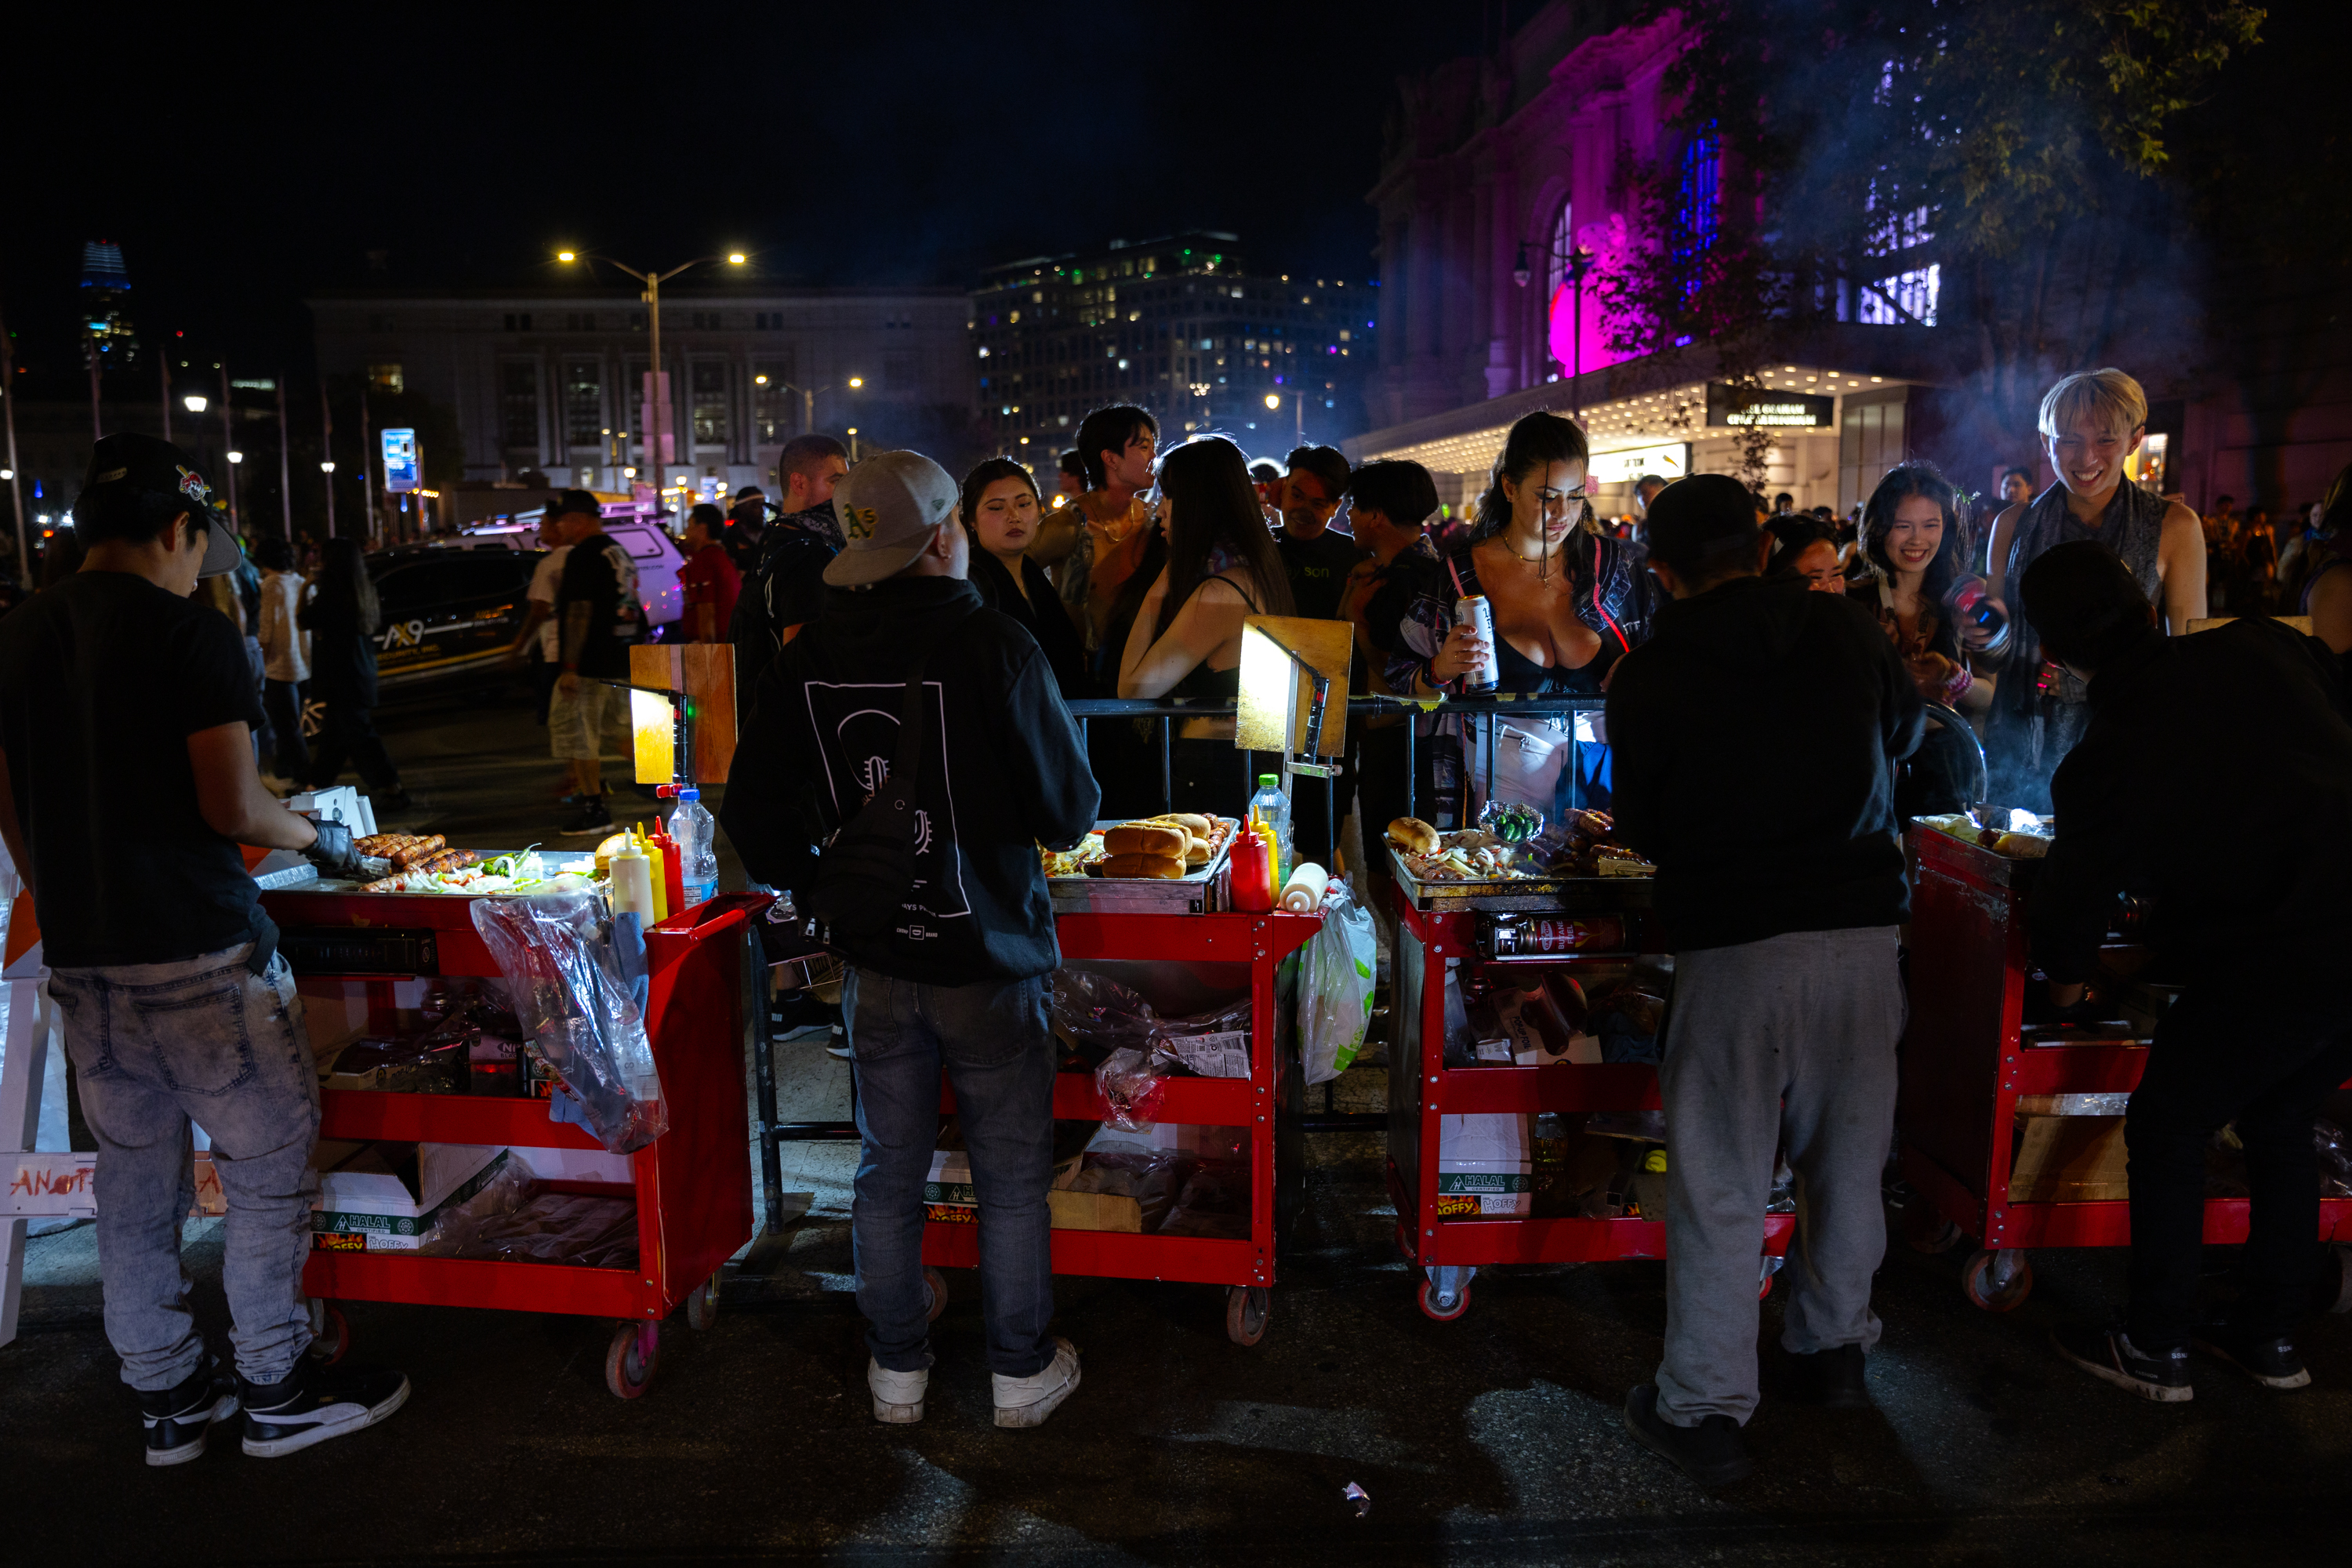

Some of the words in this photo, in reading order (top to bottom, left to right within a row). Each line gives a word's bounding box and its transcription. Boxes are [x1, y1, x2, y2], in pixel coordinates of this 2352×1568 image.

[1304, 566, 1330, 578] son
[382, 619, 424, 650] AX9
[1556, 920, 1565, 949] BUTANE
[1512, 1016, 1526, 1035] POP-UP
[1520, 1036, 1532, 1049] FOIL
[10, 1167, 95, 1196] ANOT
[1465, 1175, 1505, 1186] HALAL
[1483, 1199, 1521, 1211] HOFFY
[350, 1214, 390, 1229] HALAL
[325, 1242, 363, 1252] OFFY
[369, 1239, 408, 1251] HOFFY
